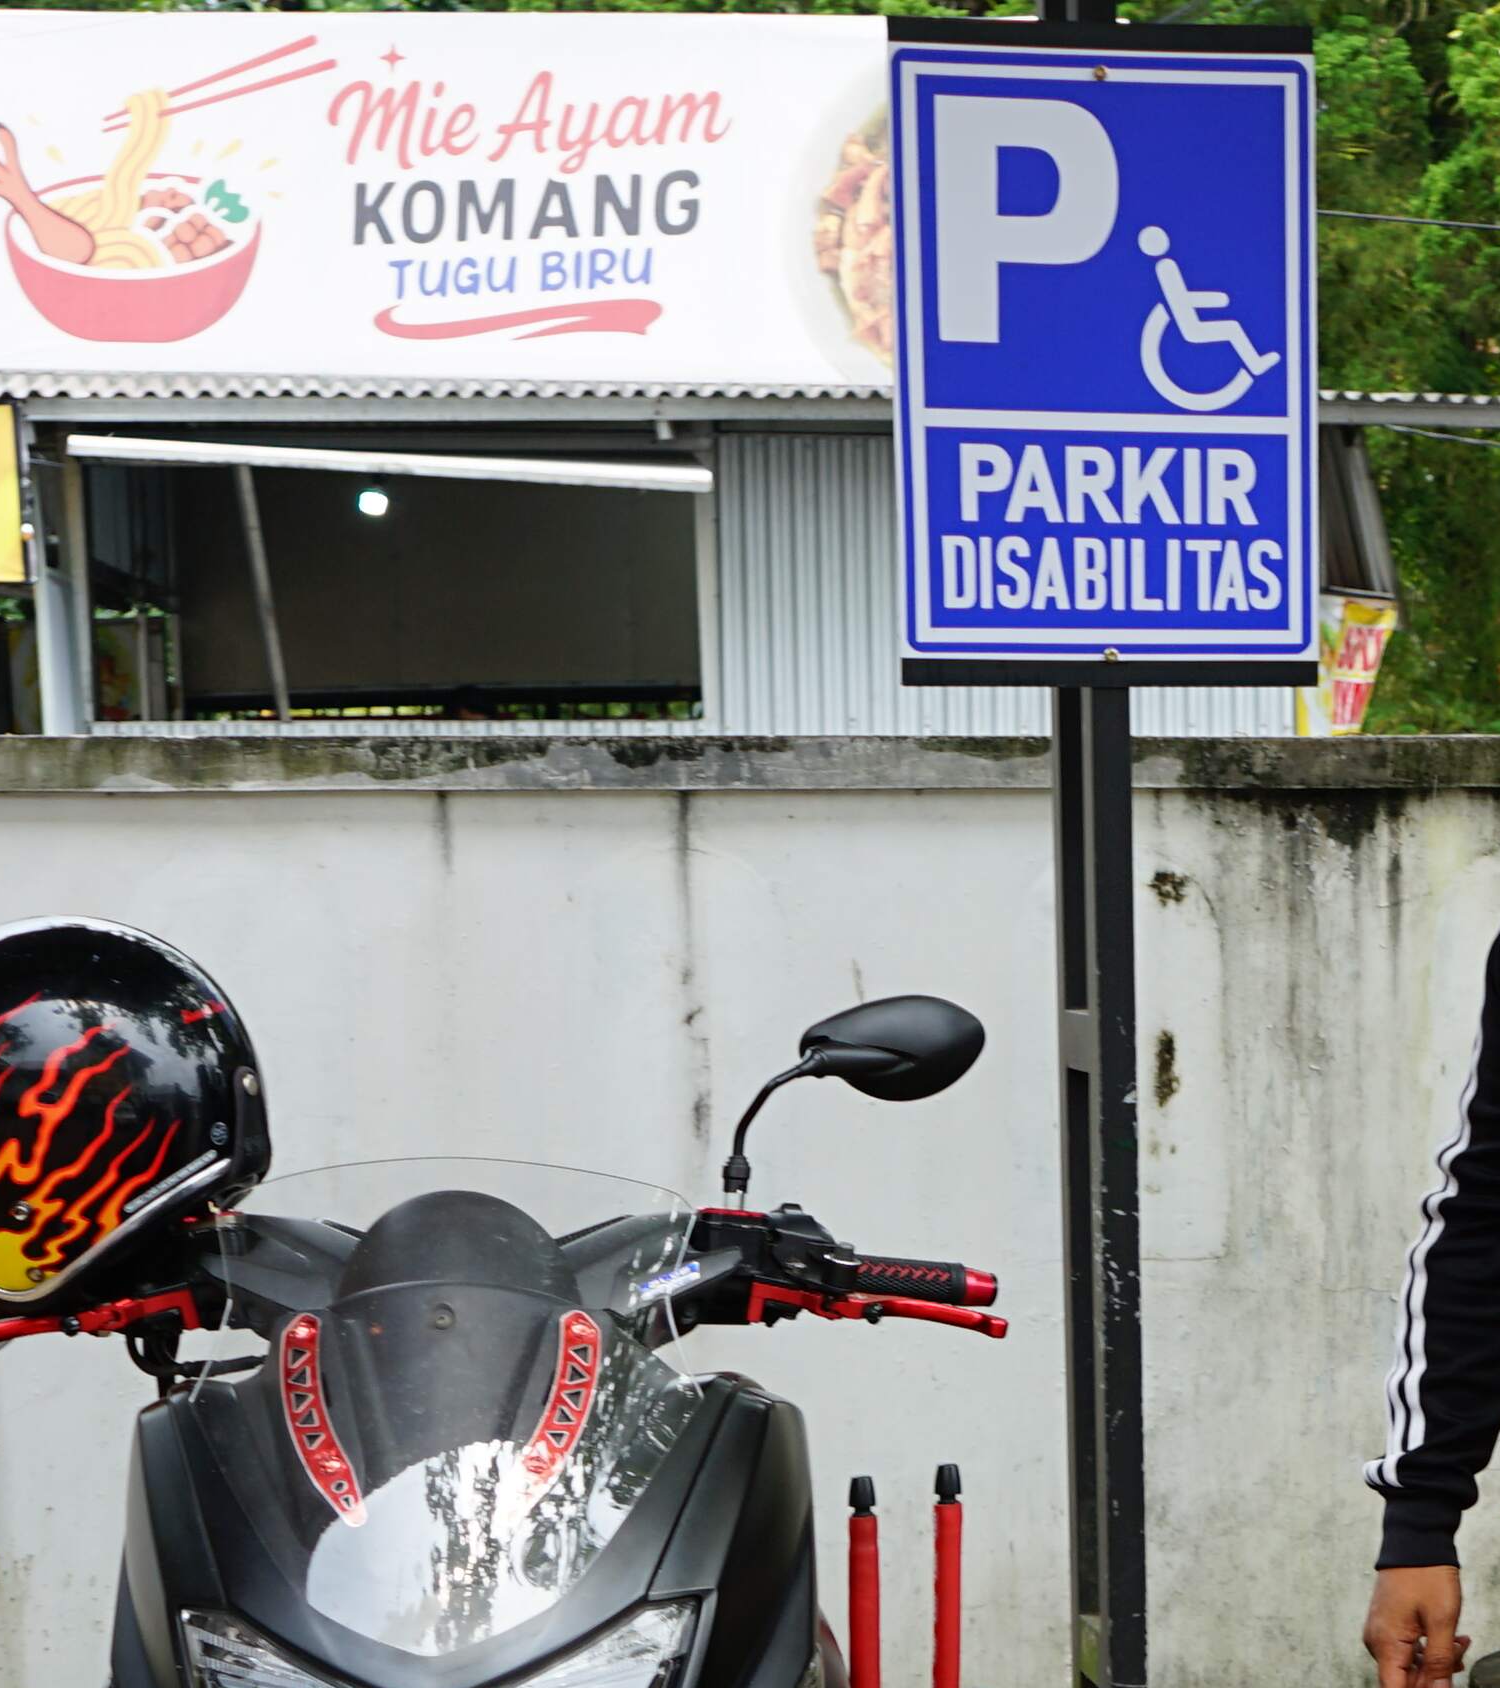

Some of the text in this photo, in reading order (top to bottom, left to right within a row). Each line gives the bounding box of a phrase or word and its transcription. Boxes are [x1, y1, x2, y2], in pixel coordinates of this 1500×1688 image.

[327, 71, 733, 173] Mie Ayam
[353, 169, 700, 246] KOMANG
[933, 94, 1119, 344] P
[388, 248, 653, 298] TUGU BIRU
[959, 442, 1260, 526] PARKIR
[940, 535, 1284, 612] DISABILITAS
